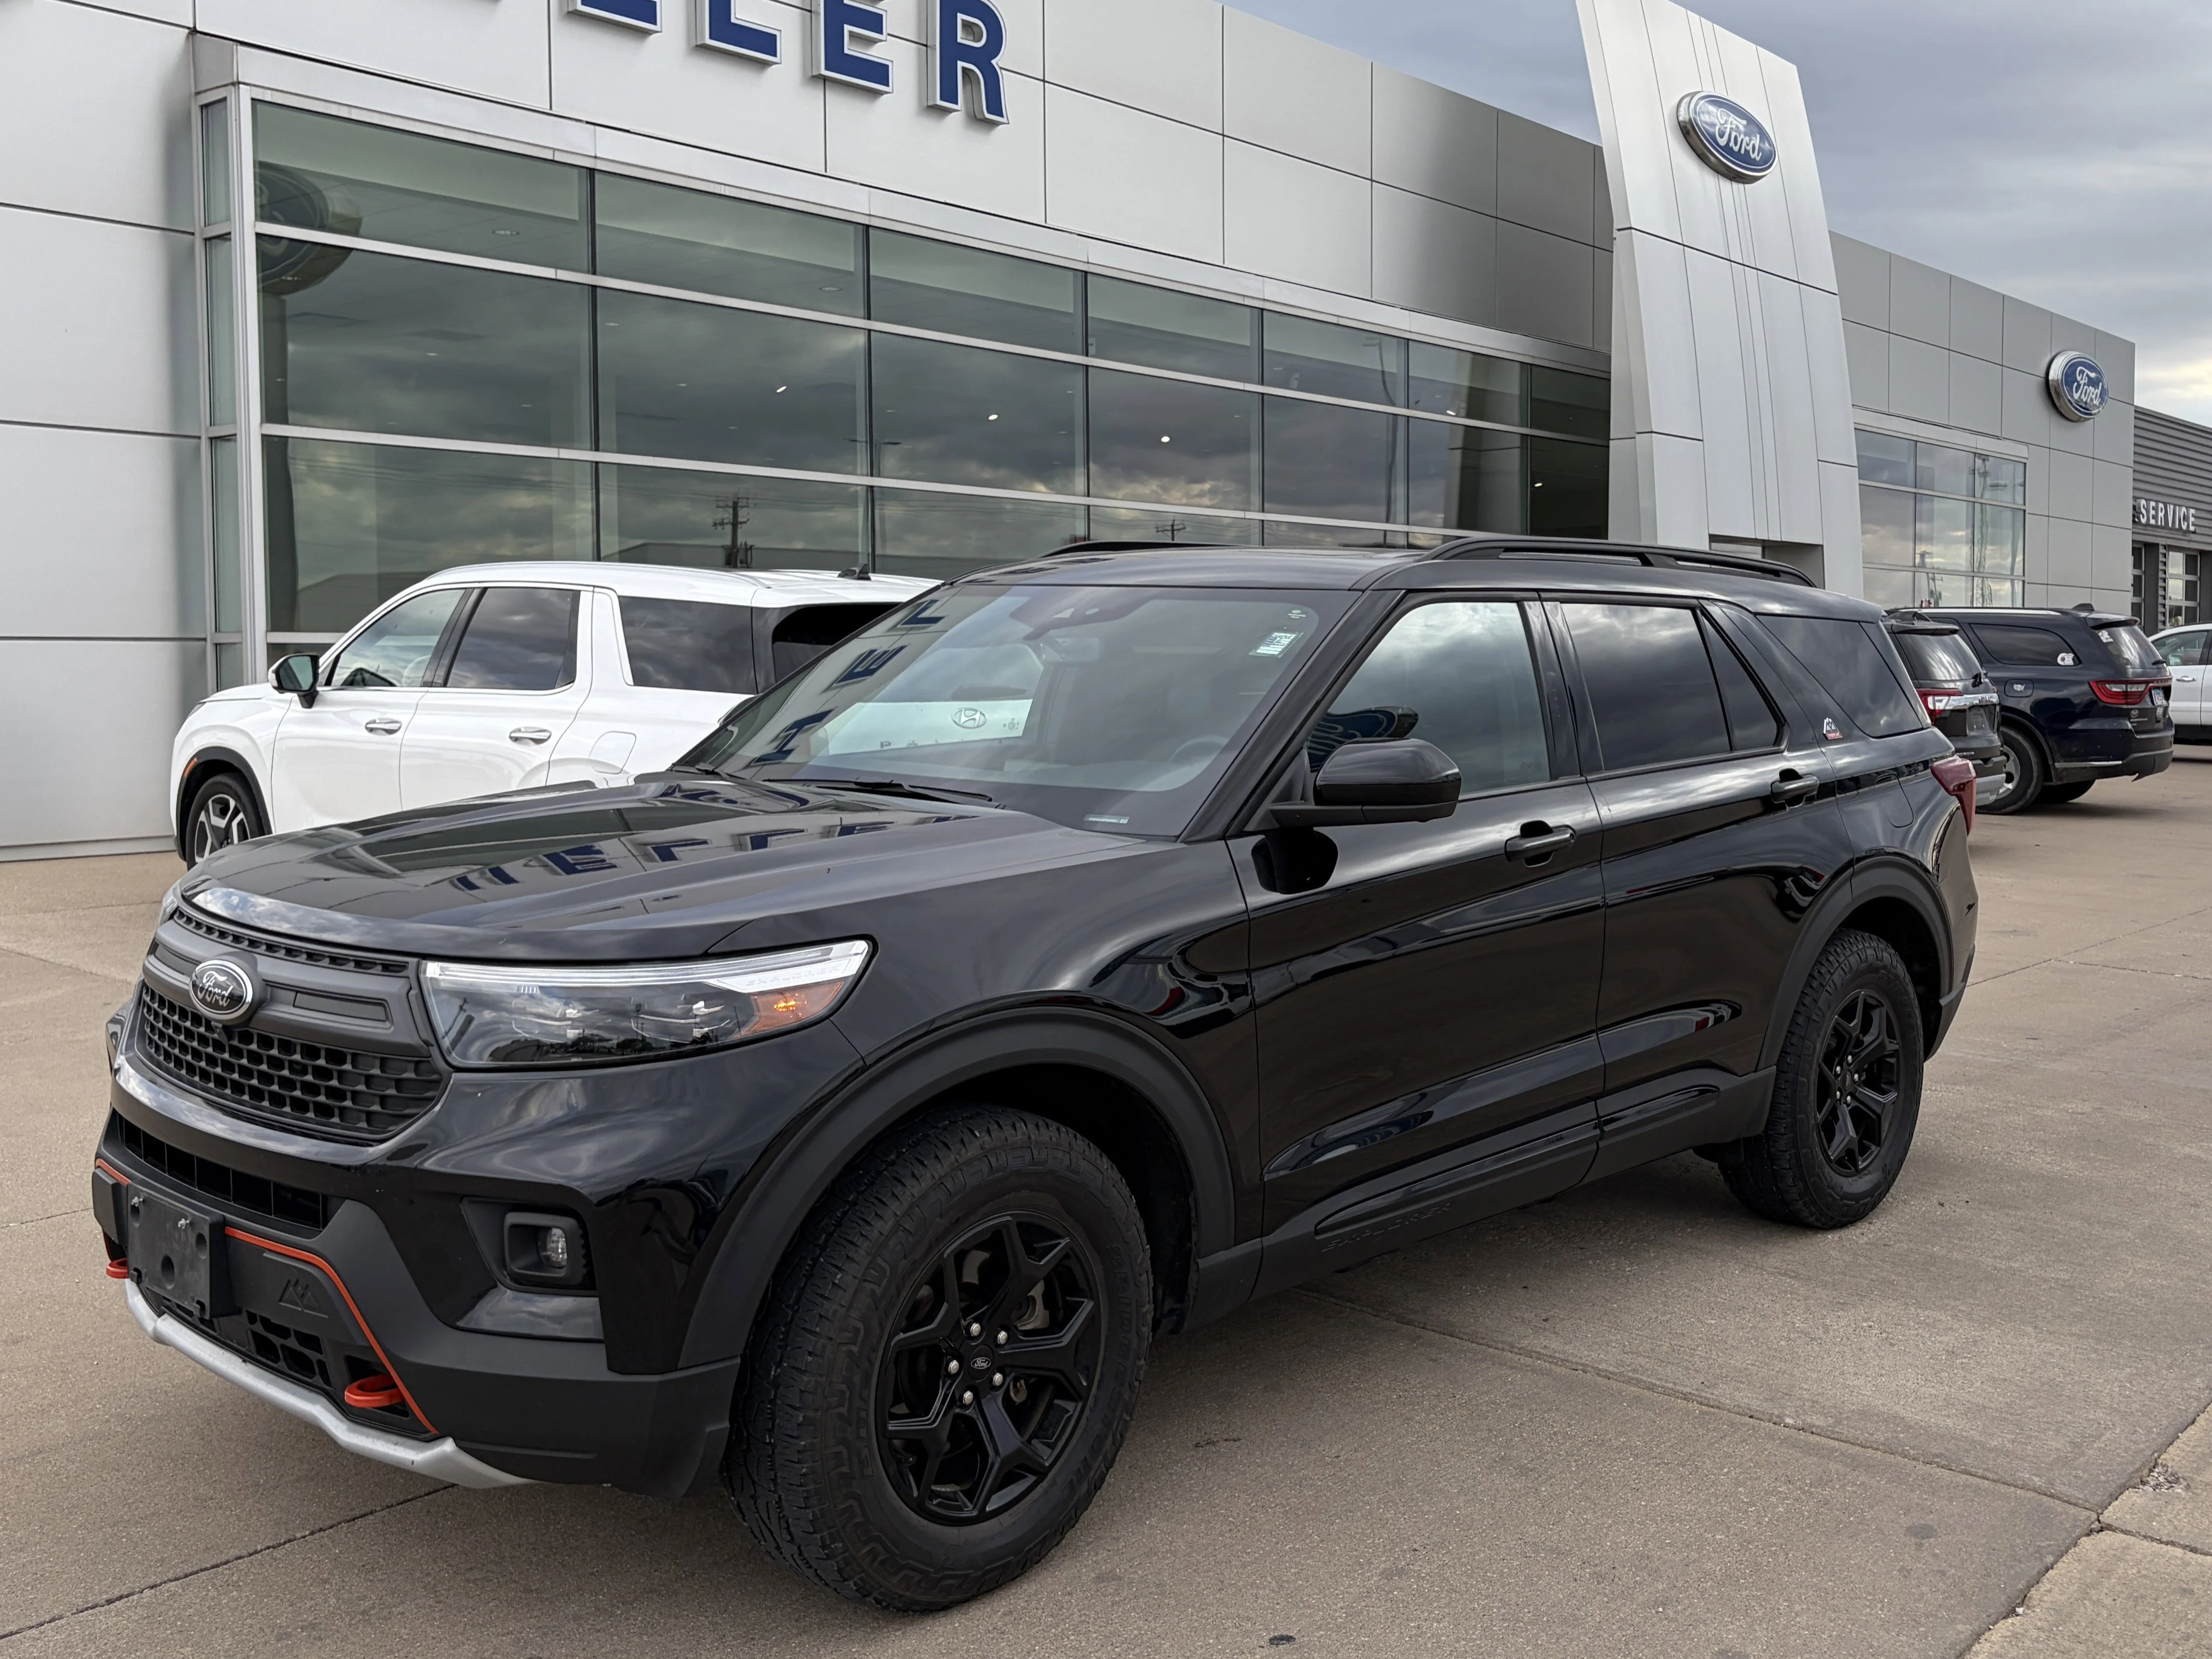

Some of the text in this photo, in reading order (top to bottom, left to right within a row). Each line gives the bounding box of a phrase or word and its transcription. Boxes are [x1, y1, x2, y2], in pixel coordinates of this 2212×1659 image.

[567, 0, 1009, 125] LER
[1716, 108, 1762, 161] Ford
[2073, 367, 2102, 406] Ford
[2140, 498, 2196, 532] SERVICE
[197, 971, 233, 1007] Ford
[974, 1358, 989, 1367] Ford
